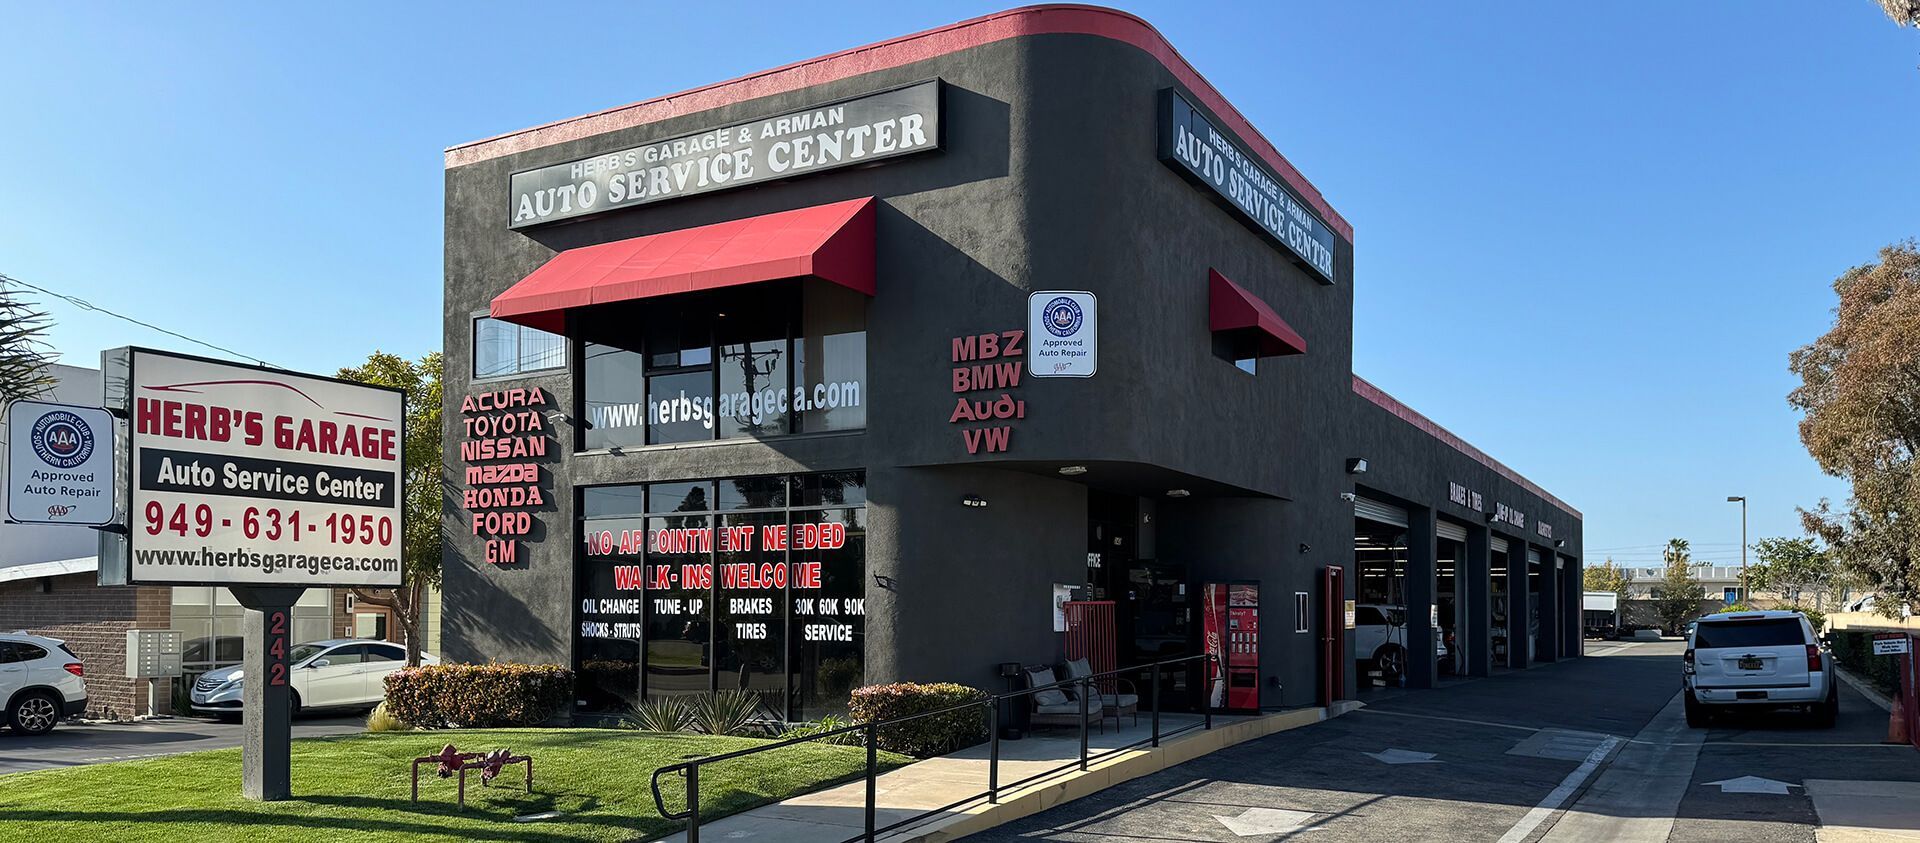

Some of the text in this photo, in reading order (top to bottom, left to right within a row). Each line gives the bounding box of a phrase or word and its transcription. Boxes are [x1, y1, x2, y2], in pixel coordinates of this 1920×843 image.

[644, 128, 730, 162] GARAGE
[738, 127, 752, 144] &
[760, 106, 844, 139] ARMAN
[514, 113, 927, 222] AUTO SERVICE CENTER
[1176, 125, 1332, 278] AUTO SERVICE CENTER
[1243, 160, 1277, 200] GARAGE
[1279, 192, 1285, 208] &
[1286, 199, 1312, 232] ARMAN
[1054, 311, 1072, 321] AAA
[952, 329, 1024, 362] MBZ
[1061, 349, 1087, 358] Repair
[952, 361, 1022, 393] BMW
[459, 386, 546, 413] ACURA
[949, 393, 1025, 423] Audi
[36, 413, 91, 437] AUTOMOBILE CLUB
[137, 397, 396, 461] HERB'S GARAGE
[463, 411, 542, 437] TOYOTA
[33, 434, 93, 466] SOUTHERN CALIFORNIA
[50, 431, 77, 445] AAA
[460, 435, 545, 462] NISSAN
[962, 426, 1010, 454] VW
[31, 470, 94, 482] Approved
[157, 457, 384, 500] Auto Service Center
[24, 485, 101, 498] Auto Repair
[463, 485, 543, 509] HONDA
[472, 511, 531, 535] FORD
[485, 539, 516, 564] GM
[587, 522, 845, 555] NO APPOINTMENT NEEDED
[135, 547, 398, 575] www.herbsgarageca.com
[720, 562, 821, 589] WELCOME
[582, 598, 639, 614] OIL CHANGE
[730, 598, 773, 614] BRAKES
[795, 598, 865, 615] 30K 60K 90K
[736, 623, 767, 639] TIRES
[804, 624, 853, 641] SERVICE
